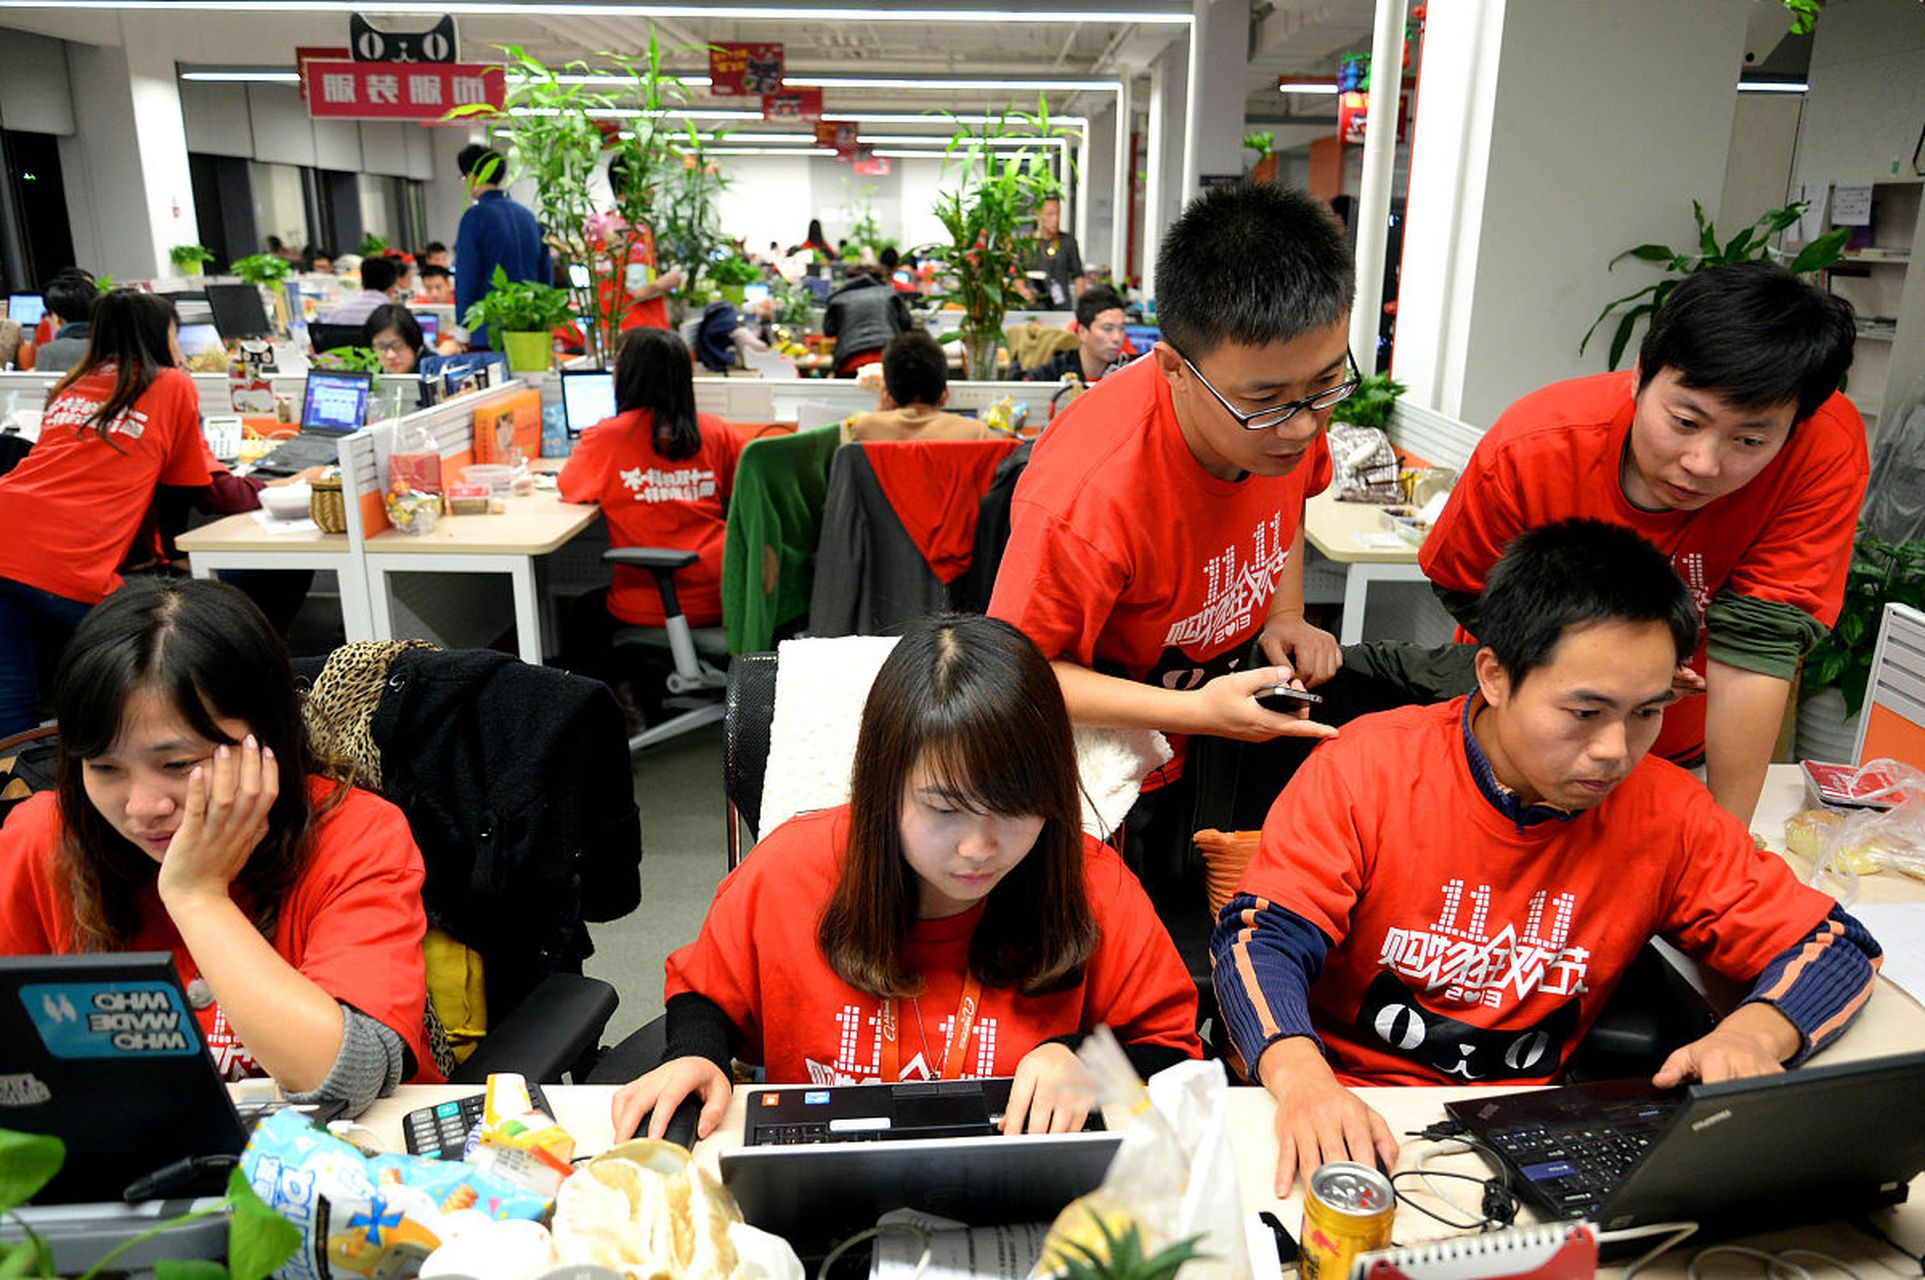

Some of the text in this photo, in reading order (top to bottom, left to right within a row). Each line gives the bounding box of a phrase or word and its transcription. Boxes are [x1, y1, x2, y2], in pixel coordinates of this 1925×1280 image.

[1161, 549, 1290, 650] 购物狂欢
[93, 991, 170, 1011] WHO
[89, 1012, 179, 1032] MADE
[113, 1032, 188, 1050] WHO
